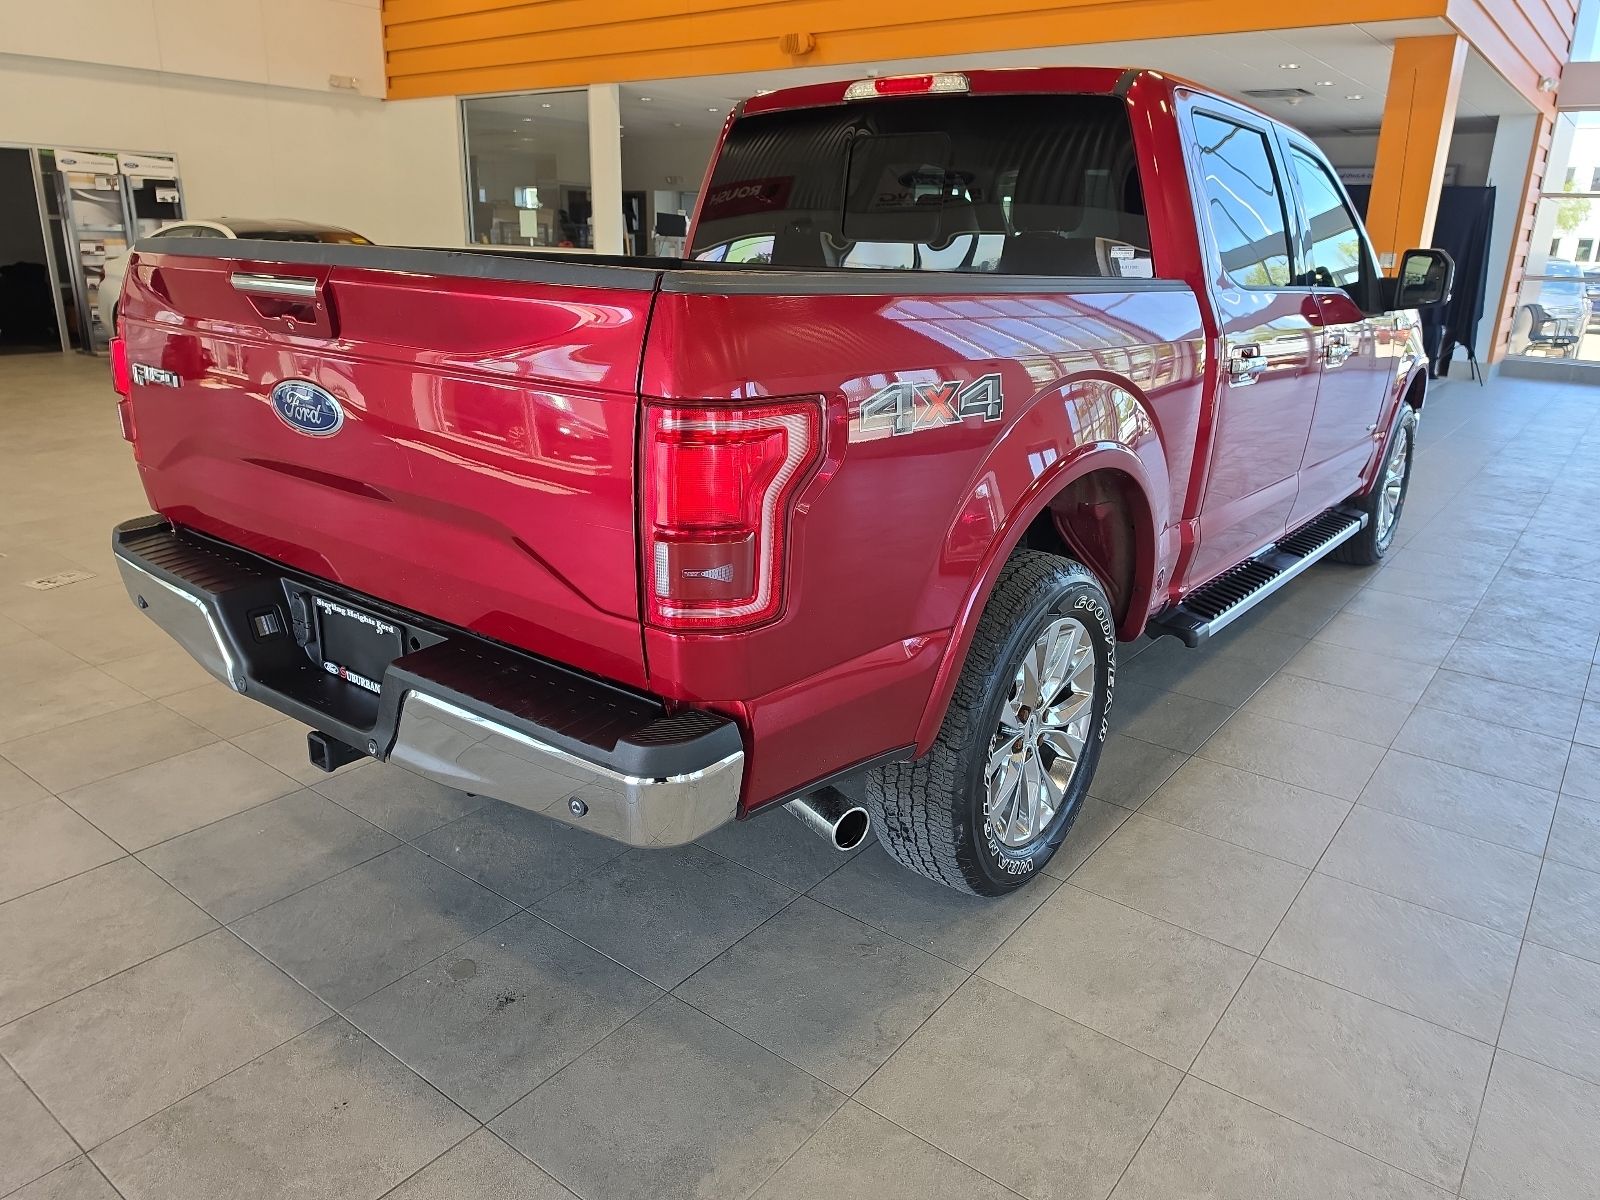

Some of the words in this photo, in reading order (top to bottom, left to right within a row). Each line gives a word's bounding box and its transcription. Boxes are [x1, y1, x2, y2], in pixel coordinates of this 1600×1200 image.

[285, 391, 322, 424] Ford
[316, 597, 347, 617] Sterling
[347, 608, 376, 627] Heights
[374, 619, 395, 635] Ford
[339, 665, 381, 694] SUBURBAN
[1073, 595, 1116, 743] GOODYEAR
